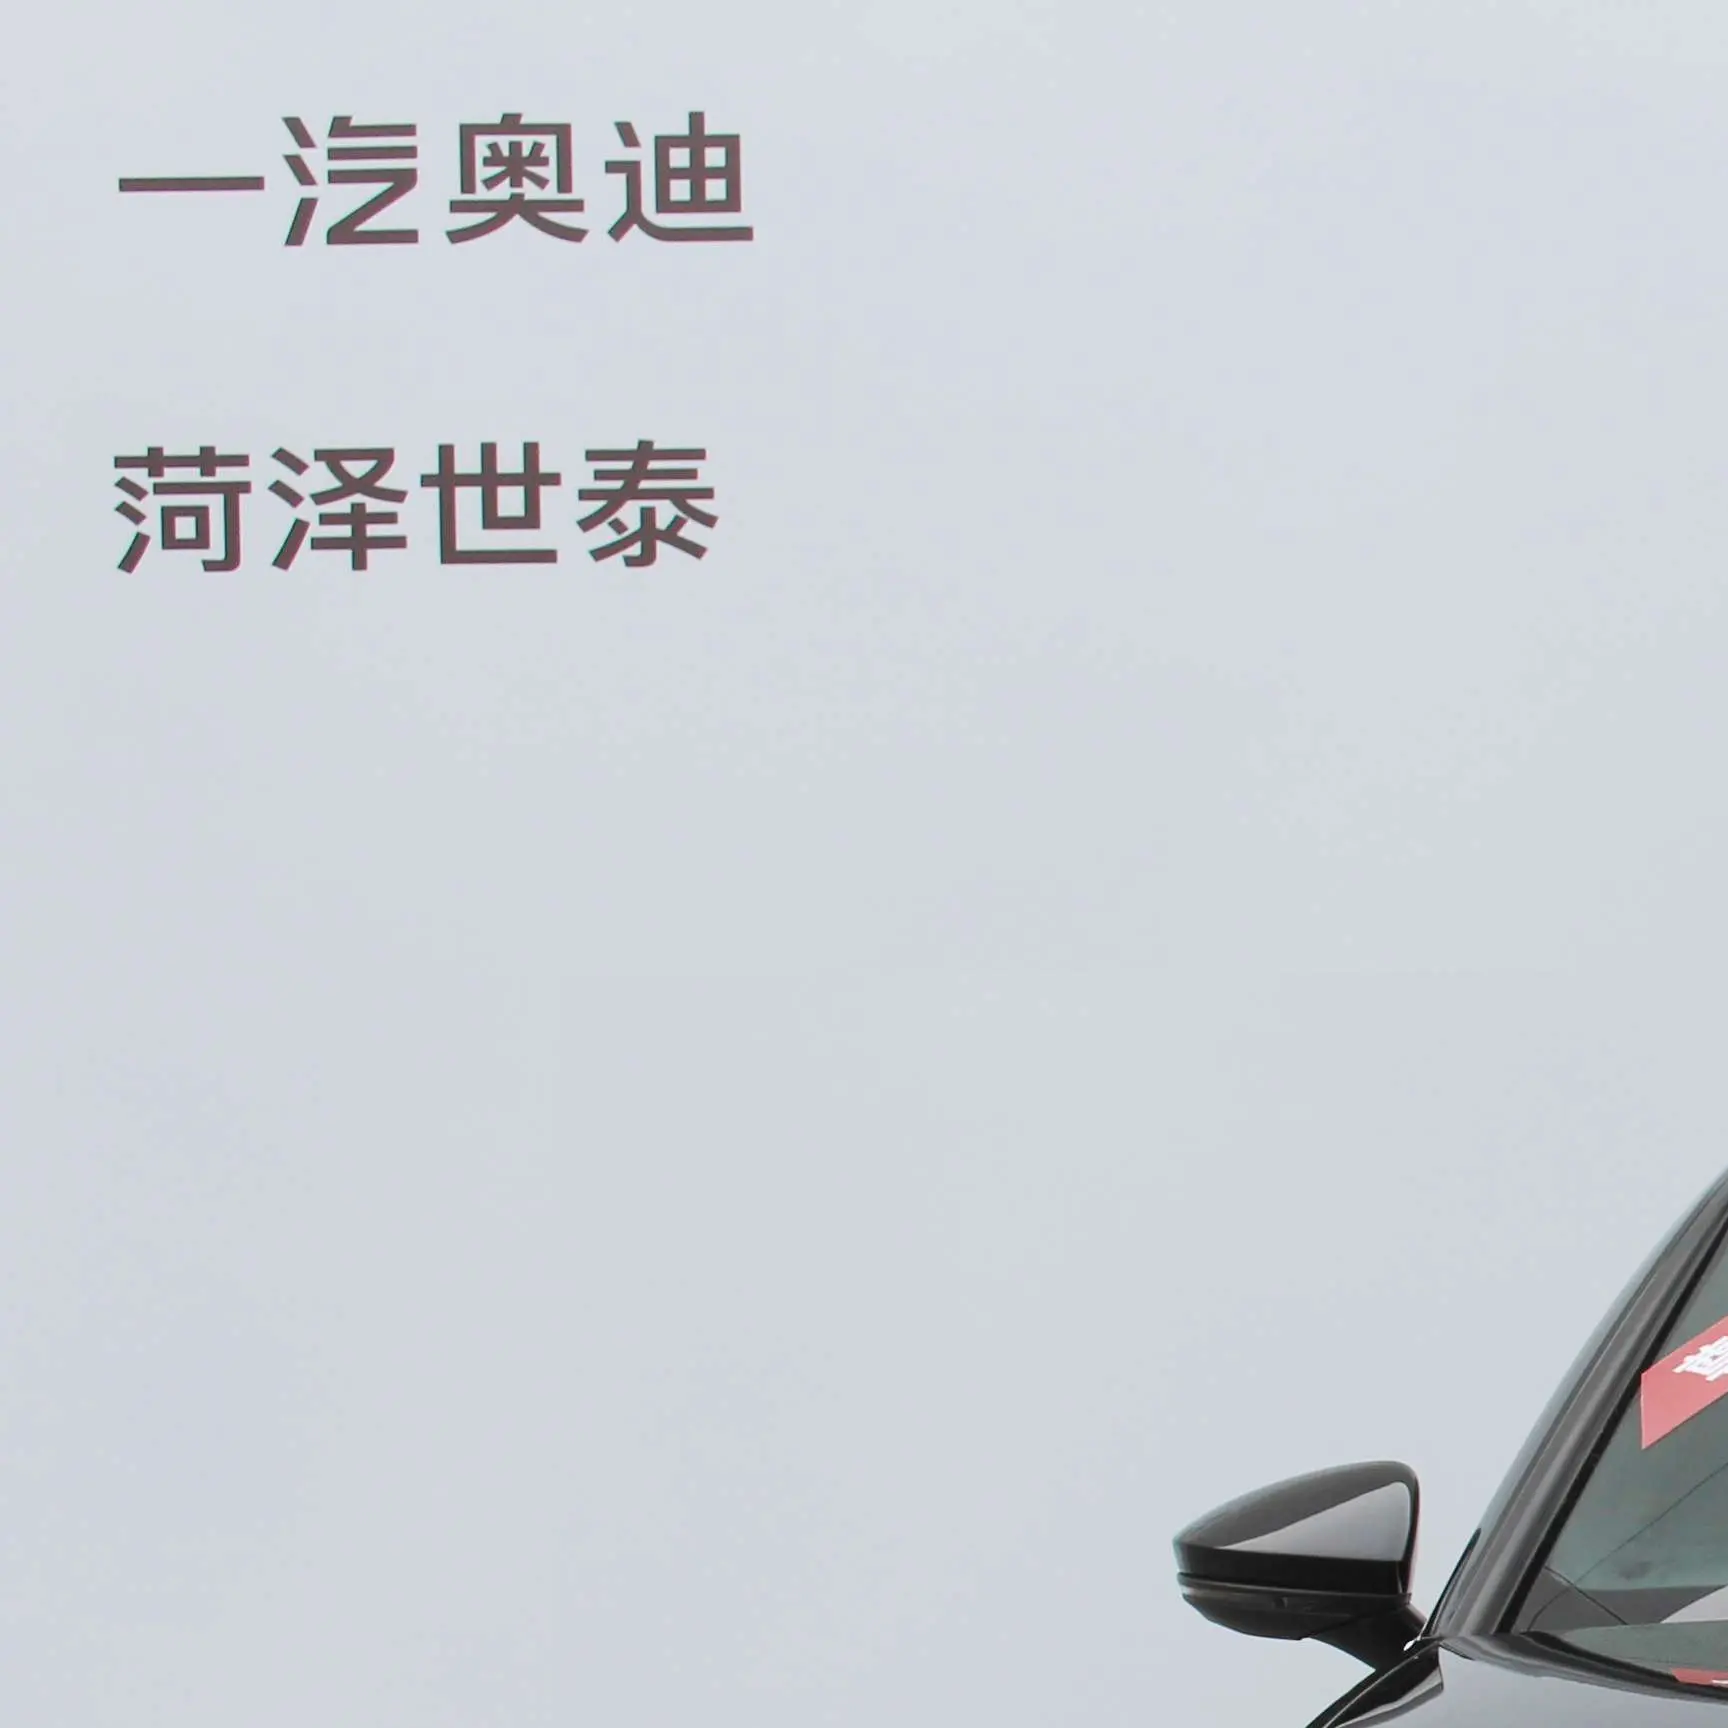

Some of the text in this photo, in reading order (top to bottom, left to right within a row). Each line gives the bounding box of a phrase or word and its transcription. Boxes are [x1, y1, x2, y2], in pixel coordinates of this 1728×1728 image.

[118, 110, 754, 247] 一汽奥迪
[113, 439, 719, 574] 菏泽世泰
